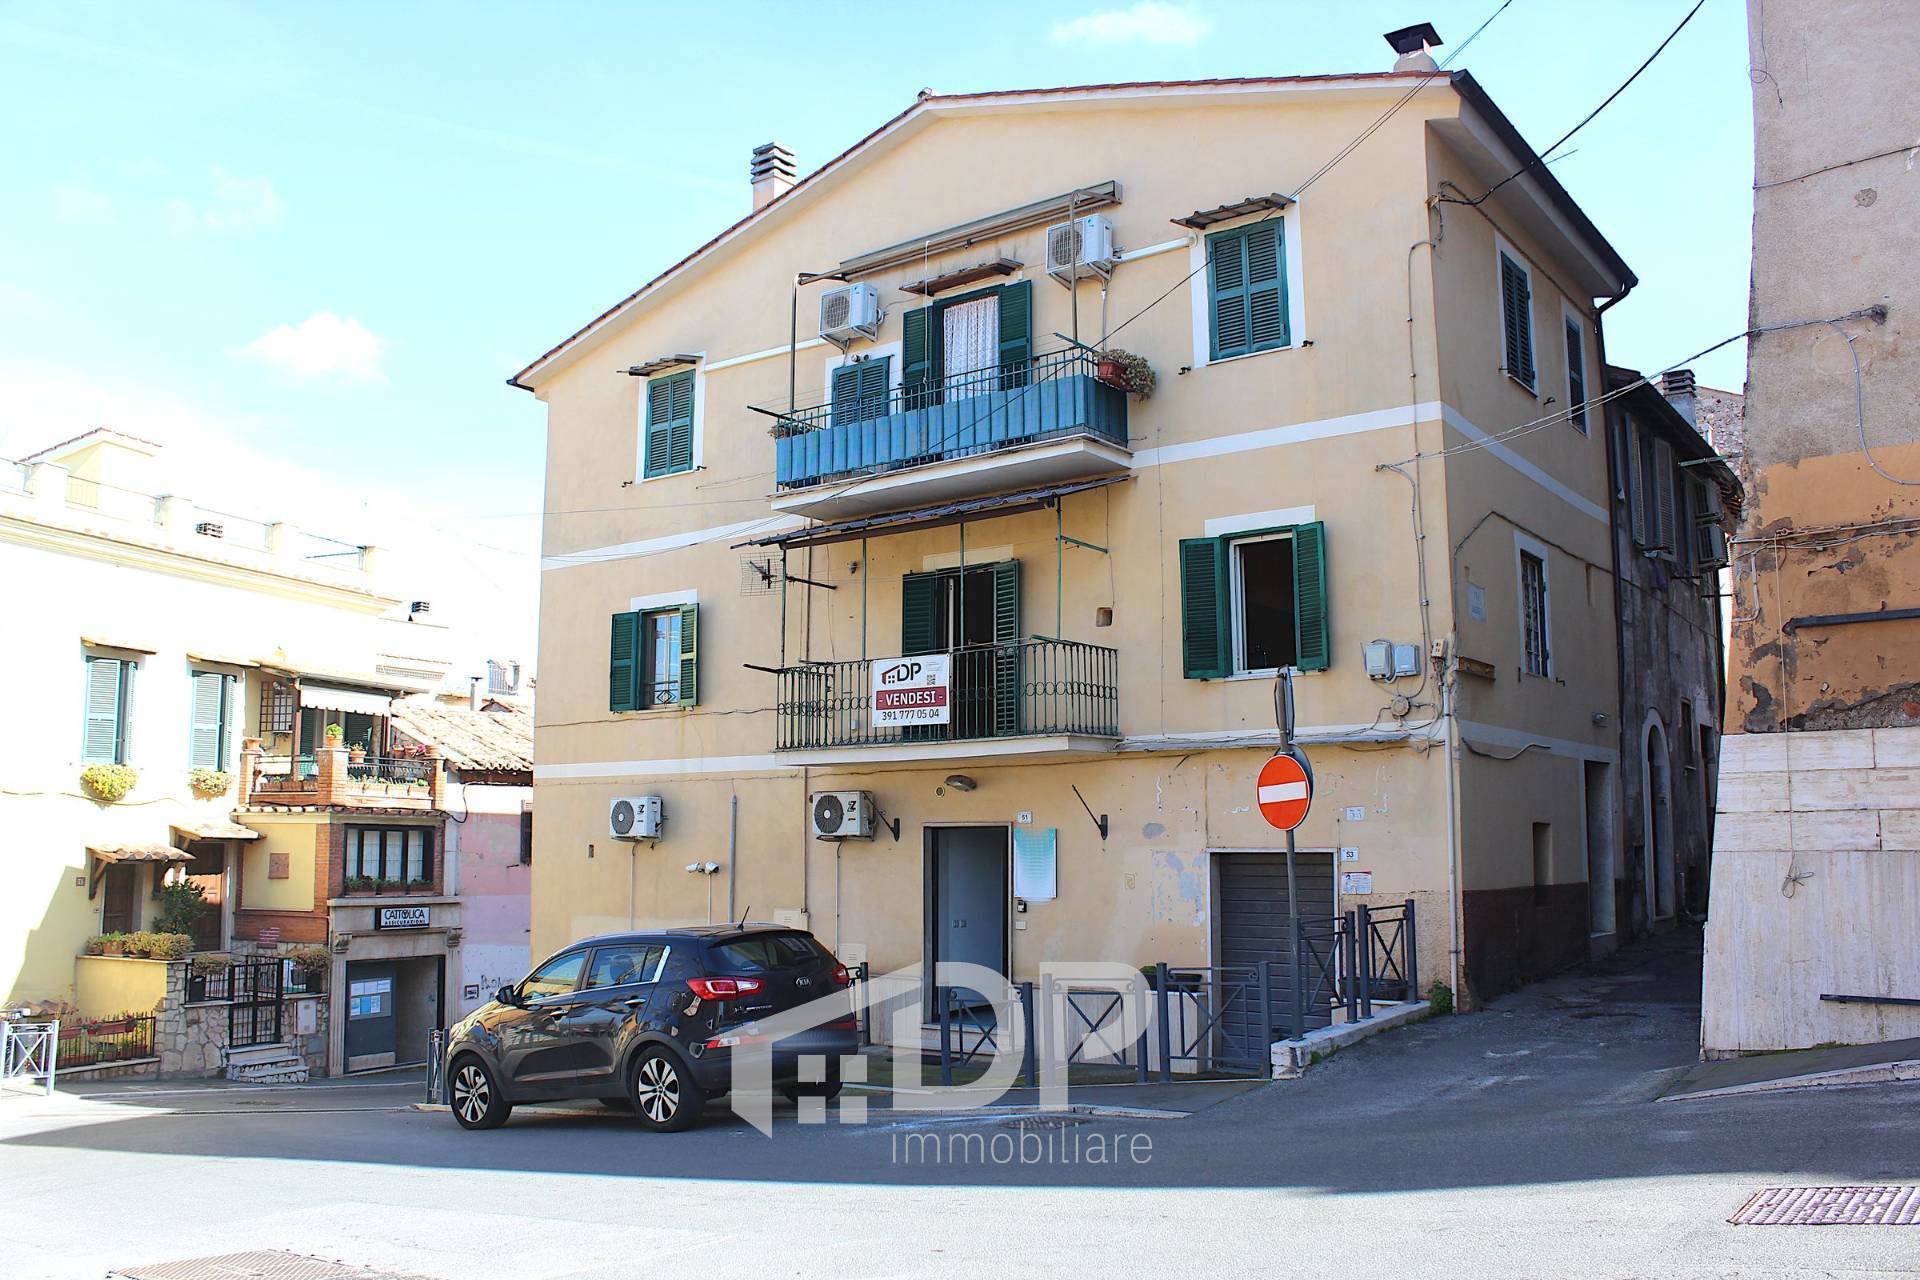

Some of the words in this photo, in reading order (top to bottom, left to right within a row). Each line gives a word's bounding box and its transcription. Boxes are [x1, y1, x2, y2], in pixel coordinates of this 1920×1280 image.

[897, 662, 922, 682] DP
[886, 690, 936, 706] VENDESI
[882, 711, 898, 720] 391
[900, 710, 915, 720] 777
[916, 708, 927, 718] 05
[928, 708, 940, 718] 04
[384, 909, 424, 920] CATTOLICA
